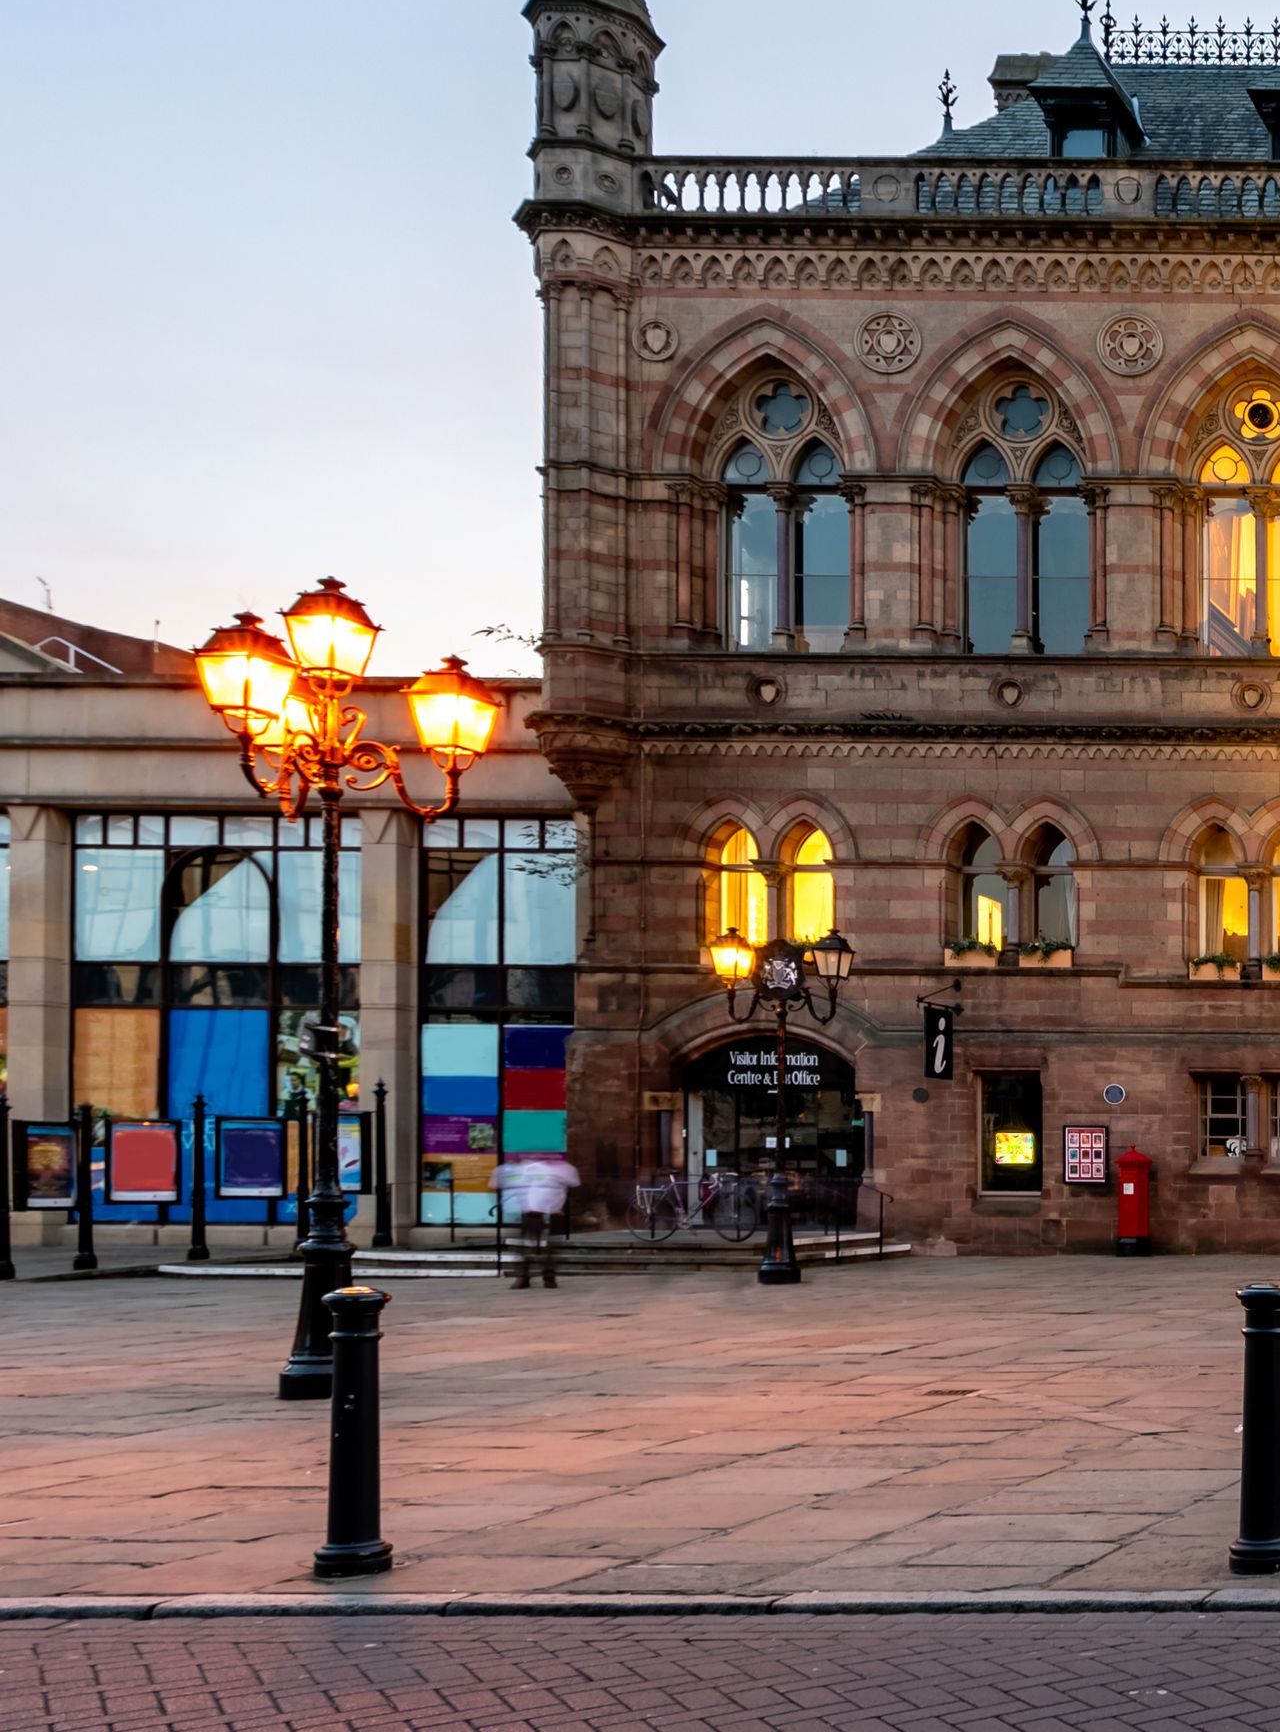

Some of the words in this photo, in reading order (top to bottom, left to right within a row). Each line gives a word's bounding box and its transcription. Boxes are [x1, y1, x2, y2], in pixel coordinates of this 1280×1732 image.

[729, 1051, 758, 1066] Visitor
[760, 1050, 818, 1066] Infomation
[727, 1069, 762, 1085] Centre
[763, 1072, 773, 1085] &
[773, 1070, 791, 1085] Bx
[791, 1070, 821, 1086] Office
